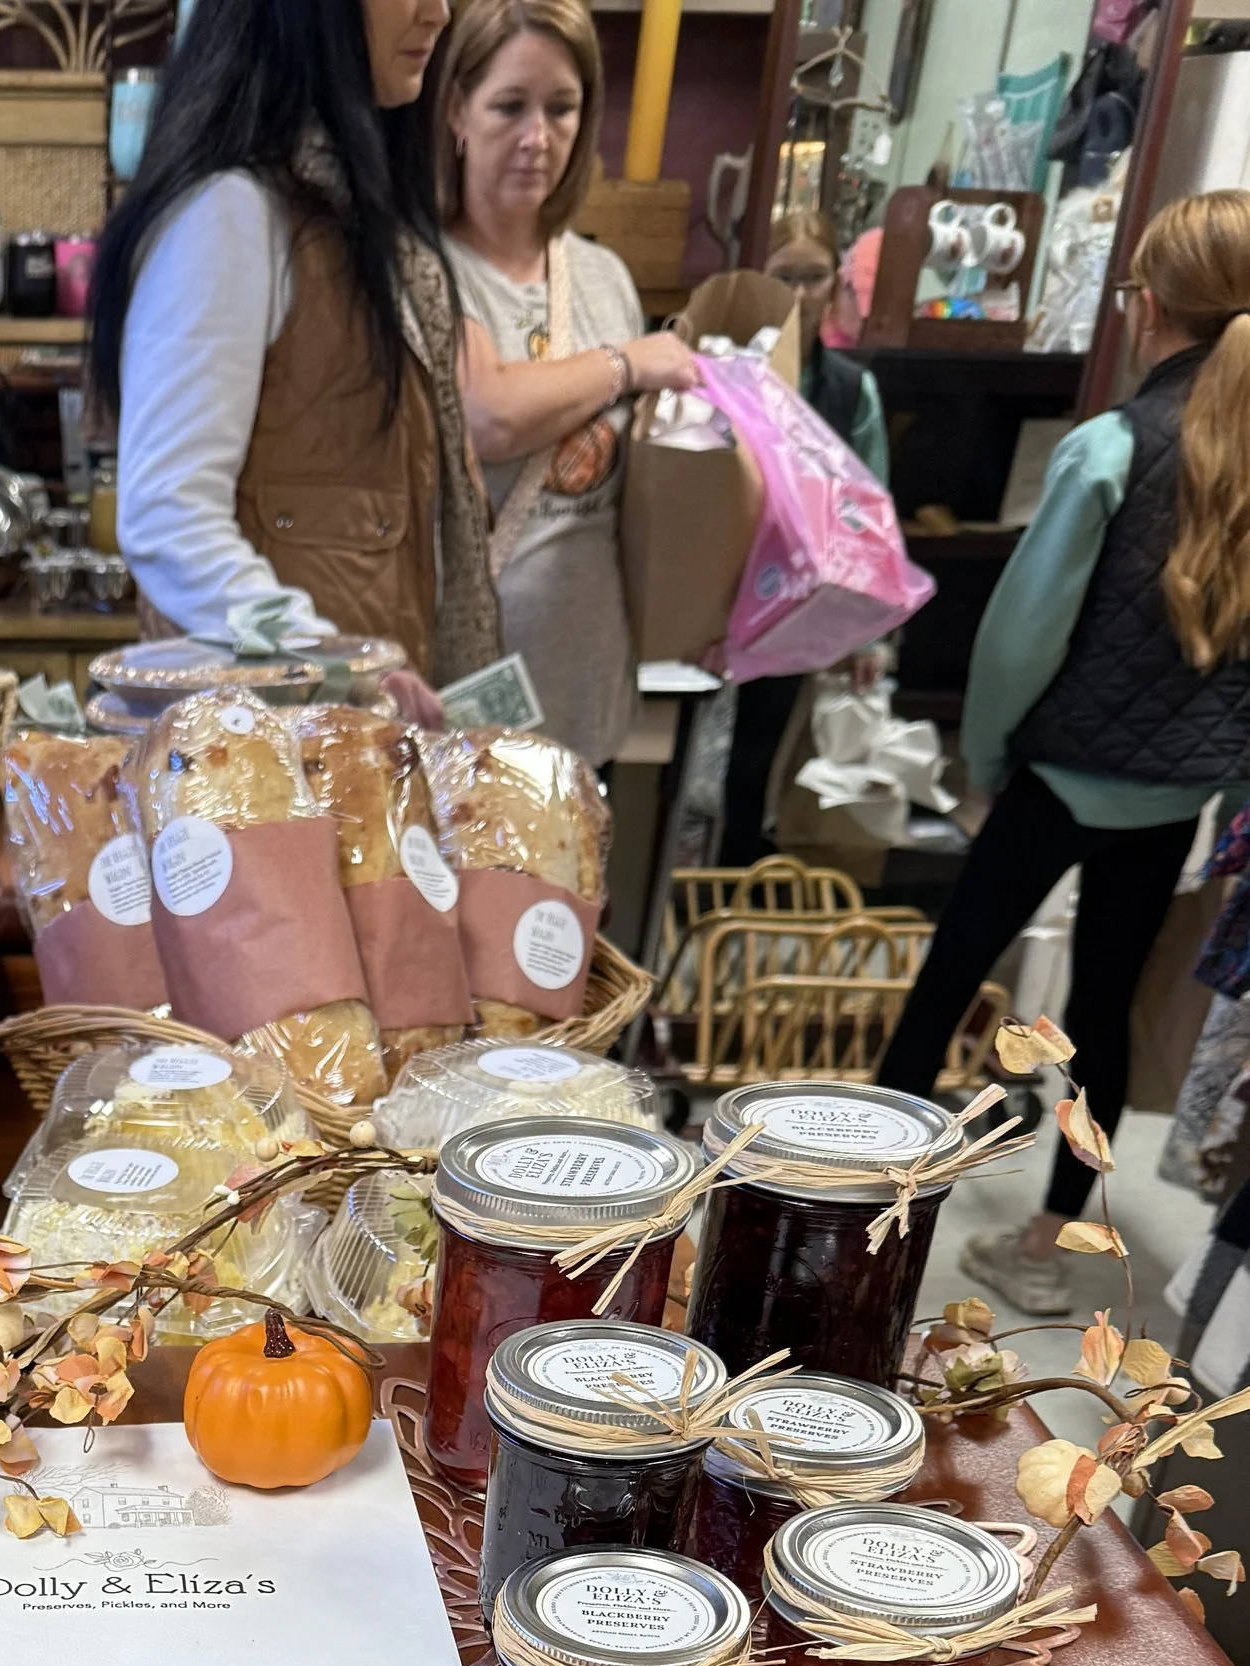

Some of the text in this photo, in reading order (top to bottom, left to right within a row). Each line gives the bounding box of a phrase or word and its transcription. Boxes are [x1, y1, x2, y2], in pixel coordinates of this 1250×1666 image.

[791, 1126, 880, 1136] BLACKBERRY
[798, 1131, 878, 1141] PRESERVES
[508, 1156, 534, 1179] DOLLY
[525, 1152, 554, 1179] ELIZA'S
[559, 1152, 590, 1187] STRAWBERRY
[579, 1157, 606, 1186] PRESERVES
[563, 1353, 618, 1364] DOLLY
[573, 1359, 637, 1370] ELIZA'S
[782, 1399, 838, 1414] DOLLY
[785, 1406, 847, 1423] ELIZA'S
[766, 1416, 850, 1435] STRAWBERRY
[770, 1423, 839, 1440] PRESERVES
[862, 1537, 945, 1558] DOLLY &
[867, 1546, 937, 1564] ELIZA'S
[849, 1559, 944, 1580] STRAWBERRY
[856, 1568, 934, 1586] PRESERVES
[101, 1576, 132, 1595] &
[144, 1572, 277, 1595] Eliza's
[586, 1584, 669, 1598] DOLLY &
[22, 1600, 231, 1611] Preserves, Pickles, and More
[592, 1592, 662, 1605] ELIZA'S
[581, 1609, 671, 1623] BLACKBERRY
[587, 1618, 665, 1631] PRESERVES
